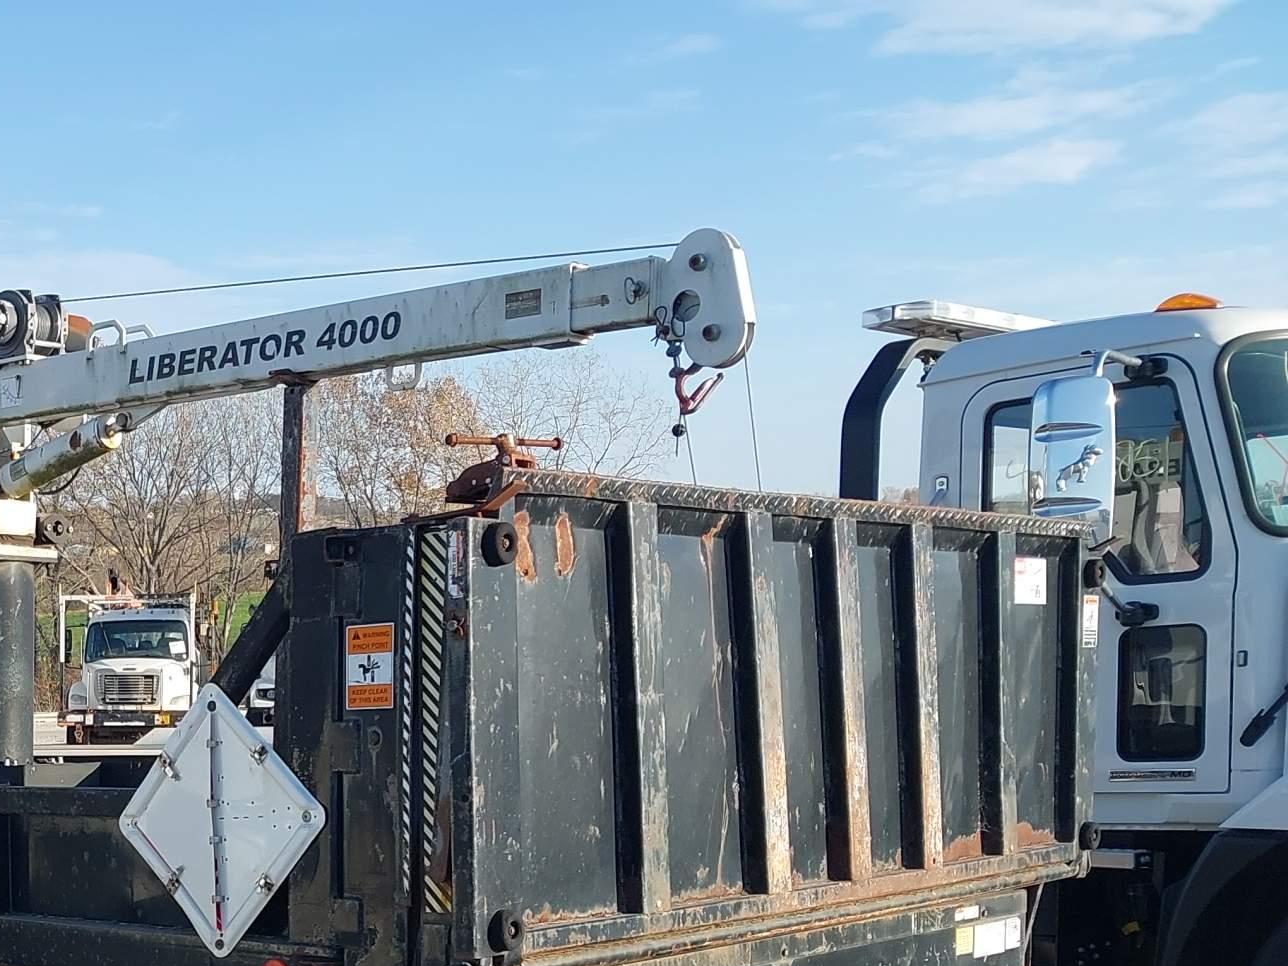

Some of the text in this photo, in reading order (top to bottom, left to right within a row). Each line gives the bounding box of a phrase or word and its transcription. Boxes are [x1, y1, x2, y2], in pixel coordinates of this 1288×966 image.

[128, 311, 402, 385] LIBERATOR 4000
[362, 630, 390, 638] WARNING
[352, 641, 388, 651] PINCH POINT
[352, 687, 388, 696] KEEP CLEAR
[349, 697, 358, 705] OF
